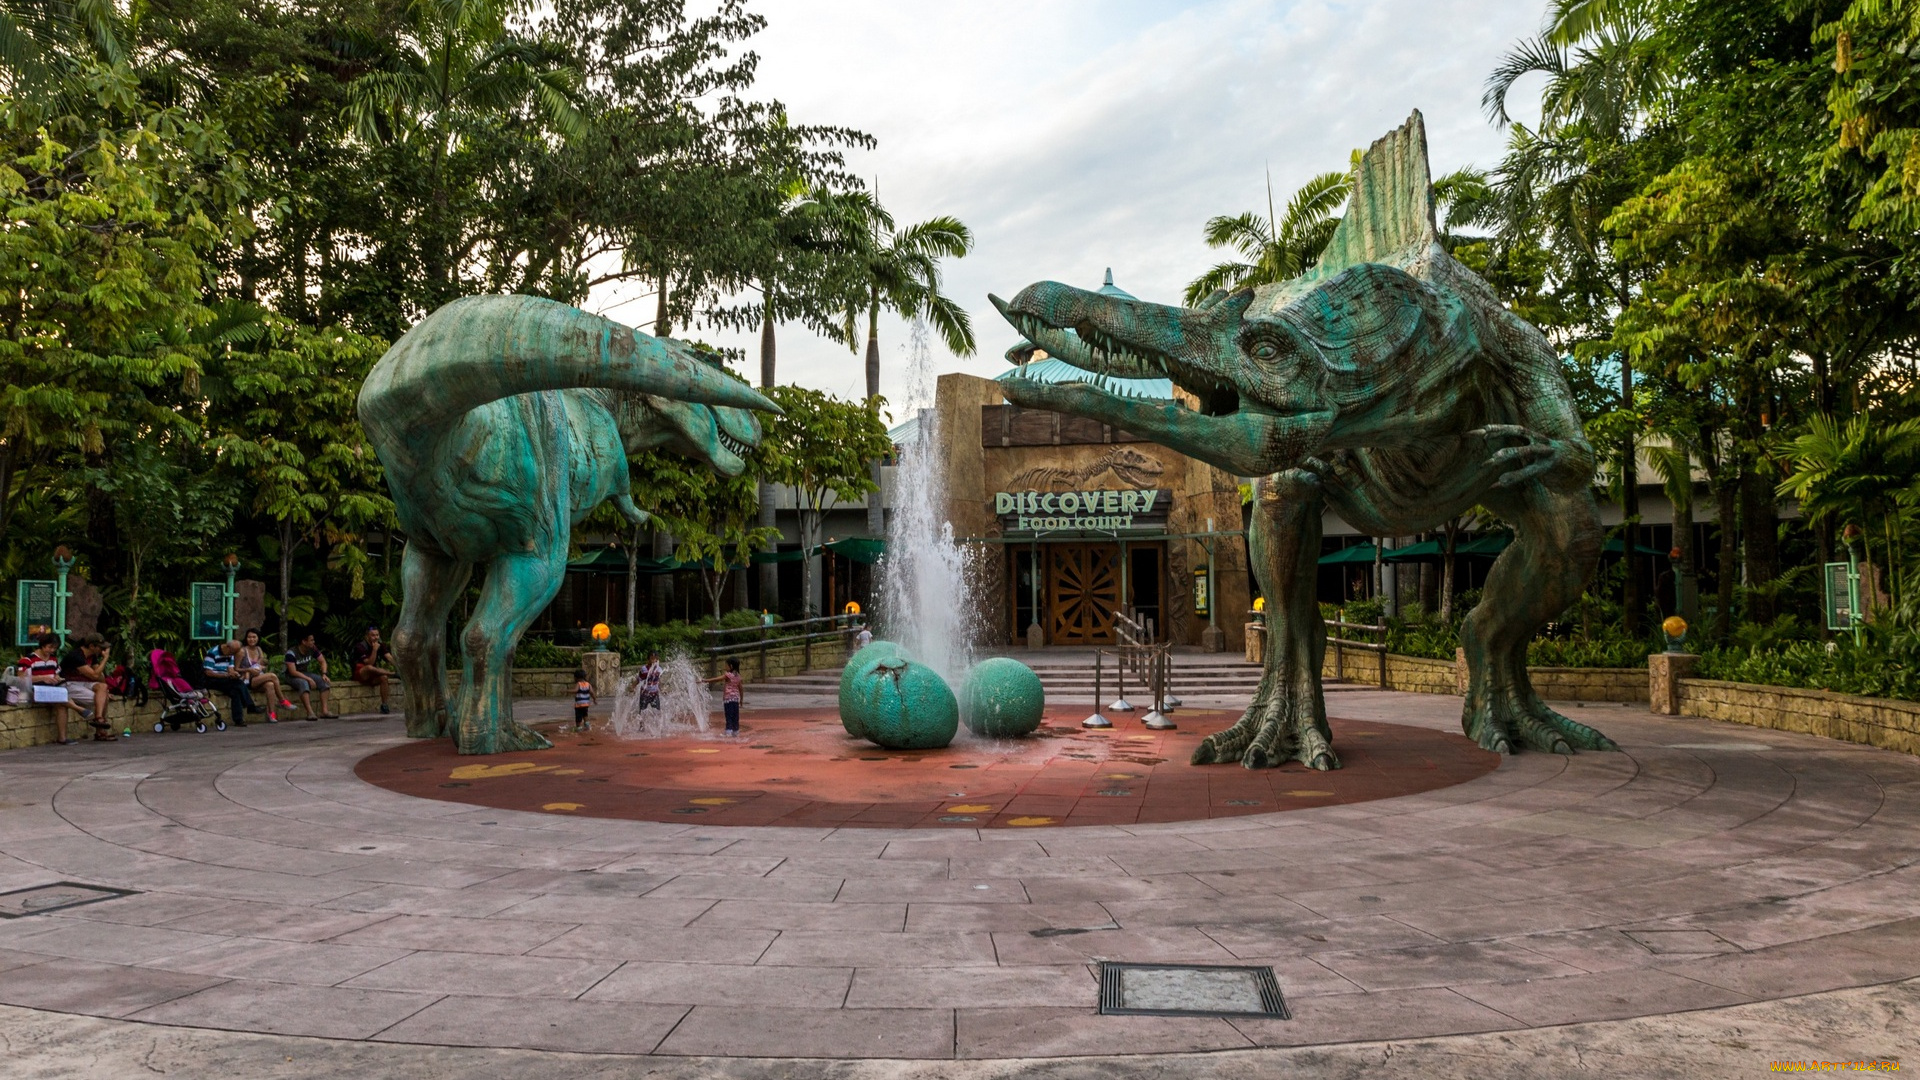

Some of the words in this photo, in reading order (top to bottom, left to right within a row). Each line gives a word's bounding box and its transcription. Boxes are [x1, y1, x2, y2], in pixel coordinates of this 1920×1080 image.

[996, 490, 1158, 515] DISCOVERY
[1018, 516, 1070, 531] FOOD
[1075, 515, 1133, 530] COURT
